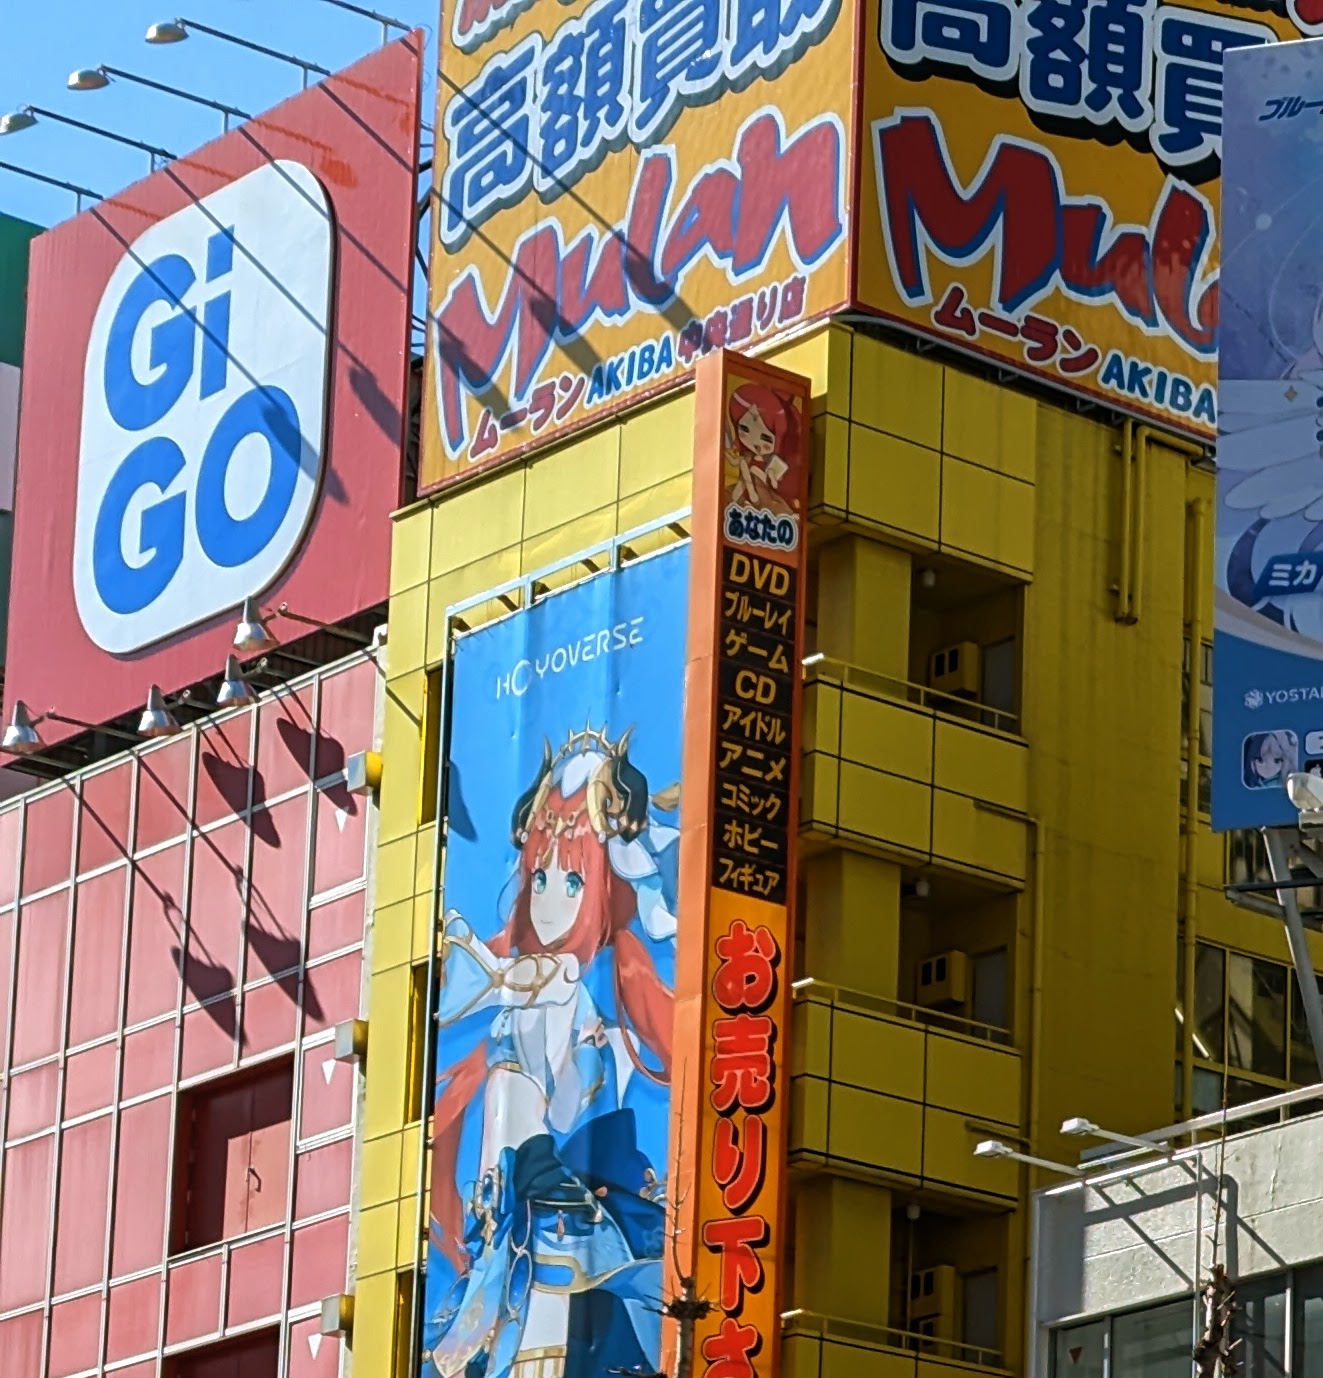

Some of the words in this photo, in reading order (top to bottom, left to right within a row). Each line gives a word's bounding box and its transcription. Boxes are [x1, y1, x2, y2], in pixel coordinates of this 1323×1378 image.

[872, 108, 1220, 360] Mul
[436, 110, 847, 460] Mulan
[932, 283, 1100, 376] ムーラン
[1100, 354, 1217, 426] AKIBA
[468, 374, 587, 459] ムーラン
[585, 335, 674, 406] AKIBA
[728, 508, 794, 548] あなたの
[729, 552, 790, 597] DVD
[1268, 559, 1318, 587] ミカ
[724, 590, 792, 636] ブルーレイ
[725, 629, 789, 675] ゲーム
[735, 670, 777, 706] CD
[722, 703, 787, 746] アイドル
[719, 741, 788, 782] アニメ
[722, 781, 782, 822] コミック
[723, 819, 779, 856] ホビー
[718, 857, 781, 897] フィギュア
